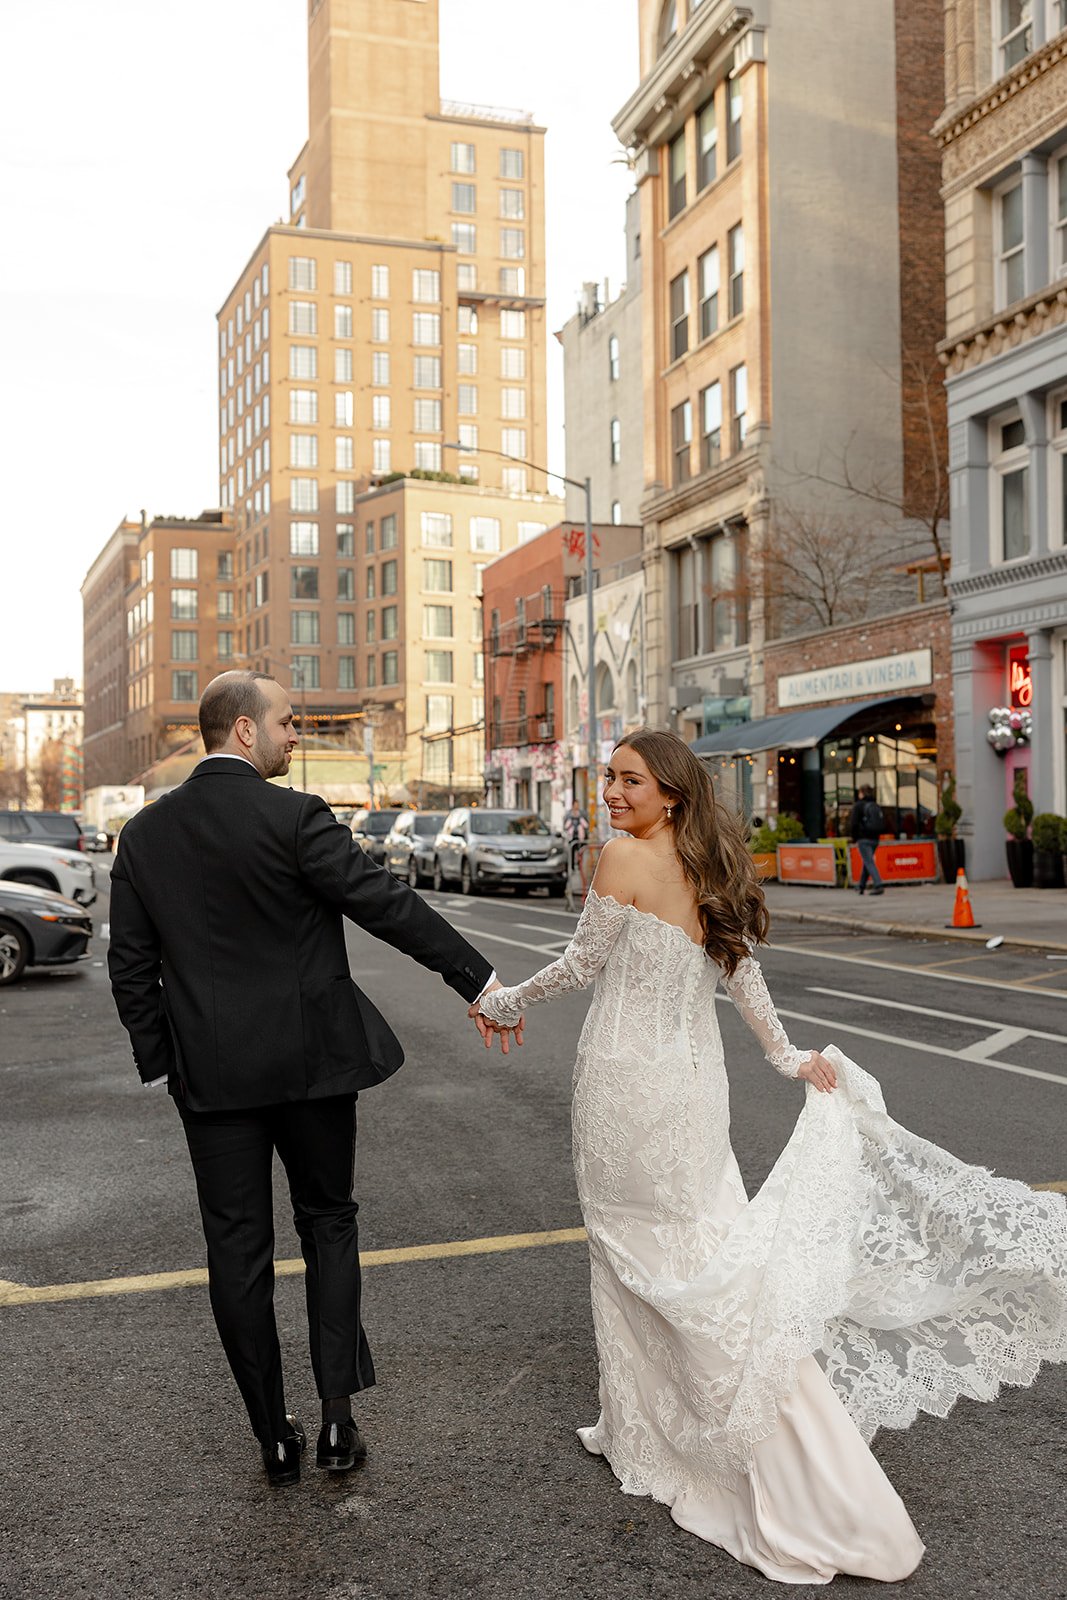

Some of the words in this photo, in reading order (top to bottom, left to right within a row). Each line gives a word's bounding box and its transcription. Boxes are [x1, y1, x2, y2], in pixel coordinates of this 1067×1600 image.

[788, 671, 853, 698] ALIMENTARI
[855, 671, 864, 686] &
[865, 660, 917, 685] VINERIA
